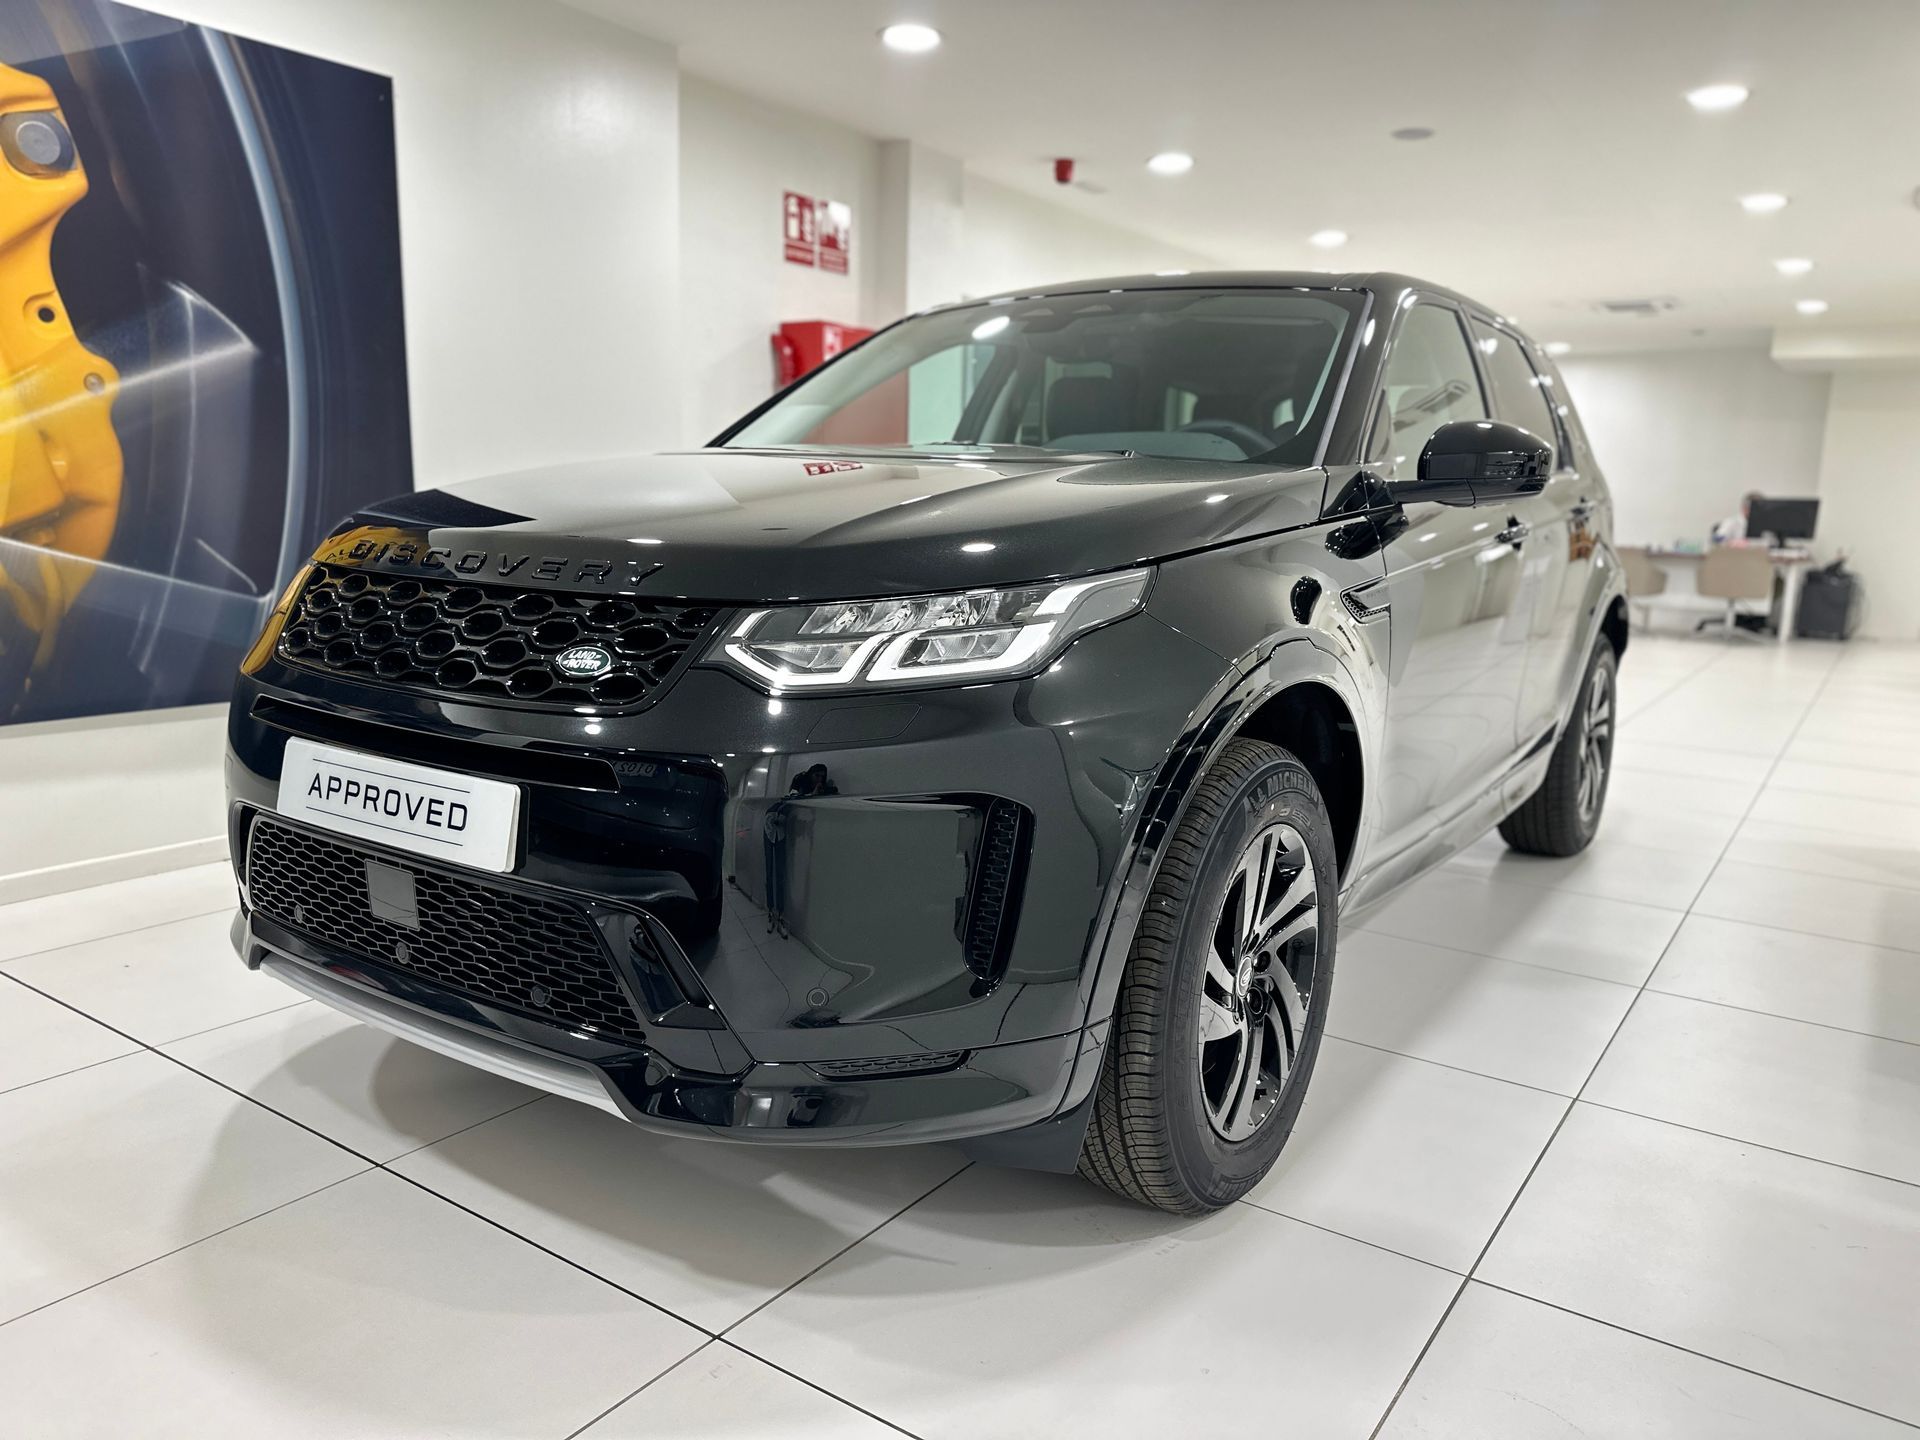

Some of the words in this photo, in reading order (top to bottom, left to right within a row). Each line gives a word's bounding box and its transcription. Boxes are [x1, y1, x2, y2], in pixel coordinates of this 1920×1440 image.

[349, 539, 664, 586] DISCOVERY
[308, 772, 468, 832] APPROVED
[1266, 771, 1320, 803] MICHELIN
